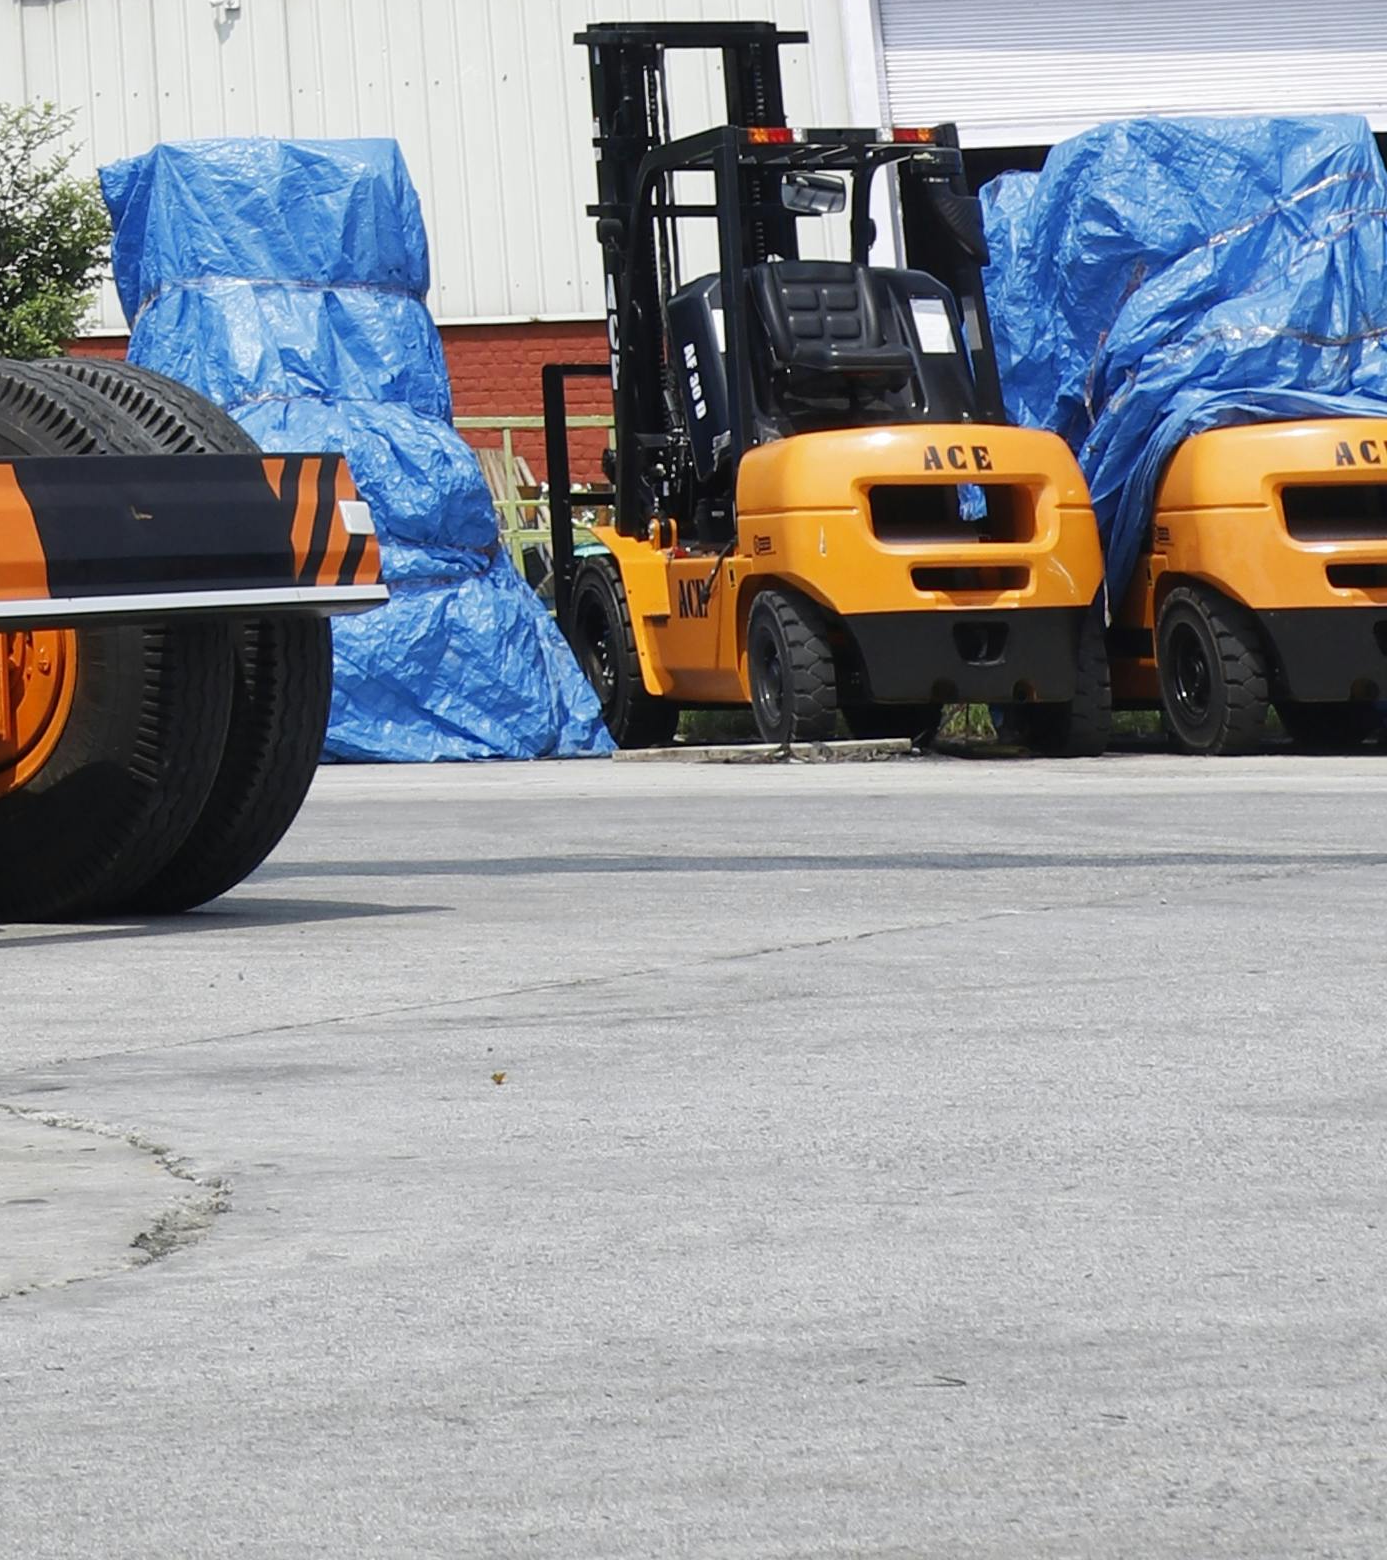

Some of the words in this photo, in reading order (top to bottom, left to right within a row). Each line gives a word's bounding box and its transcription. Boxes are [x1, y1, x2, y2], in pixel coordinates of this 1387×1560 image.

[683, 343, 698, 370] AF
[694, 399, 707, 420] D
[924, 445, 994, 472] ACE
[1336, 439, 1387, 467] AC
[679, 578, 709, 619] ACE
